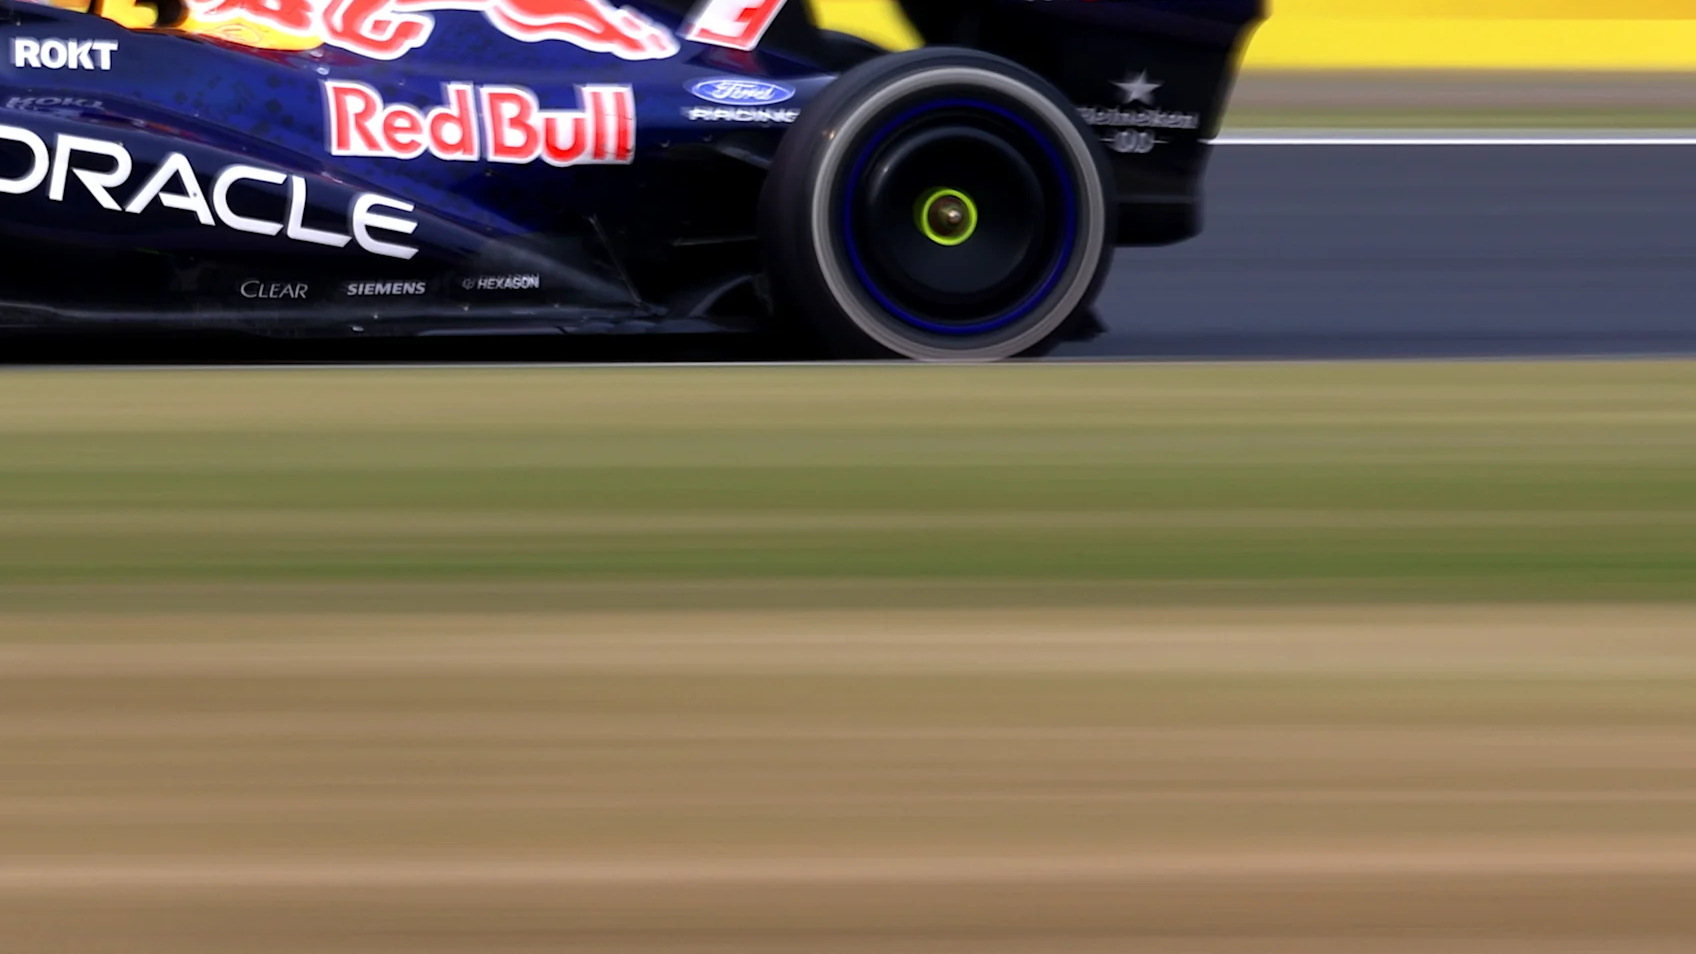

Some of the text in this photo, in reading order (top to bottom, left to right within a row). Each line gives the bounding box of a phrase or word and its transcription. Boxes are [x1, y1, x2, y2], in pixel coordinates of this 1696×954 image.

[12, 38, 118, 70] ROKT
[710, 80, 777, 101] Ford
[324, 81, 635, 167] Red Bull
[240, 279, 309, 299] CLEAR
[346, 281, 427, 295] SIEMENS
[476, 274, 540, 289] HEXAGON
